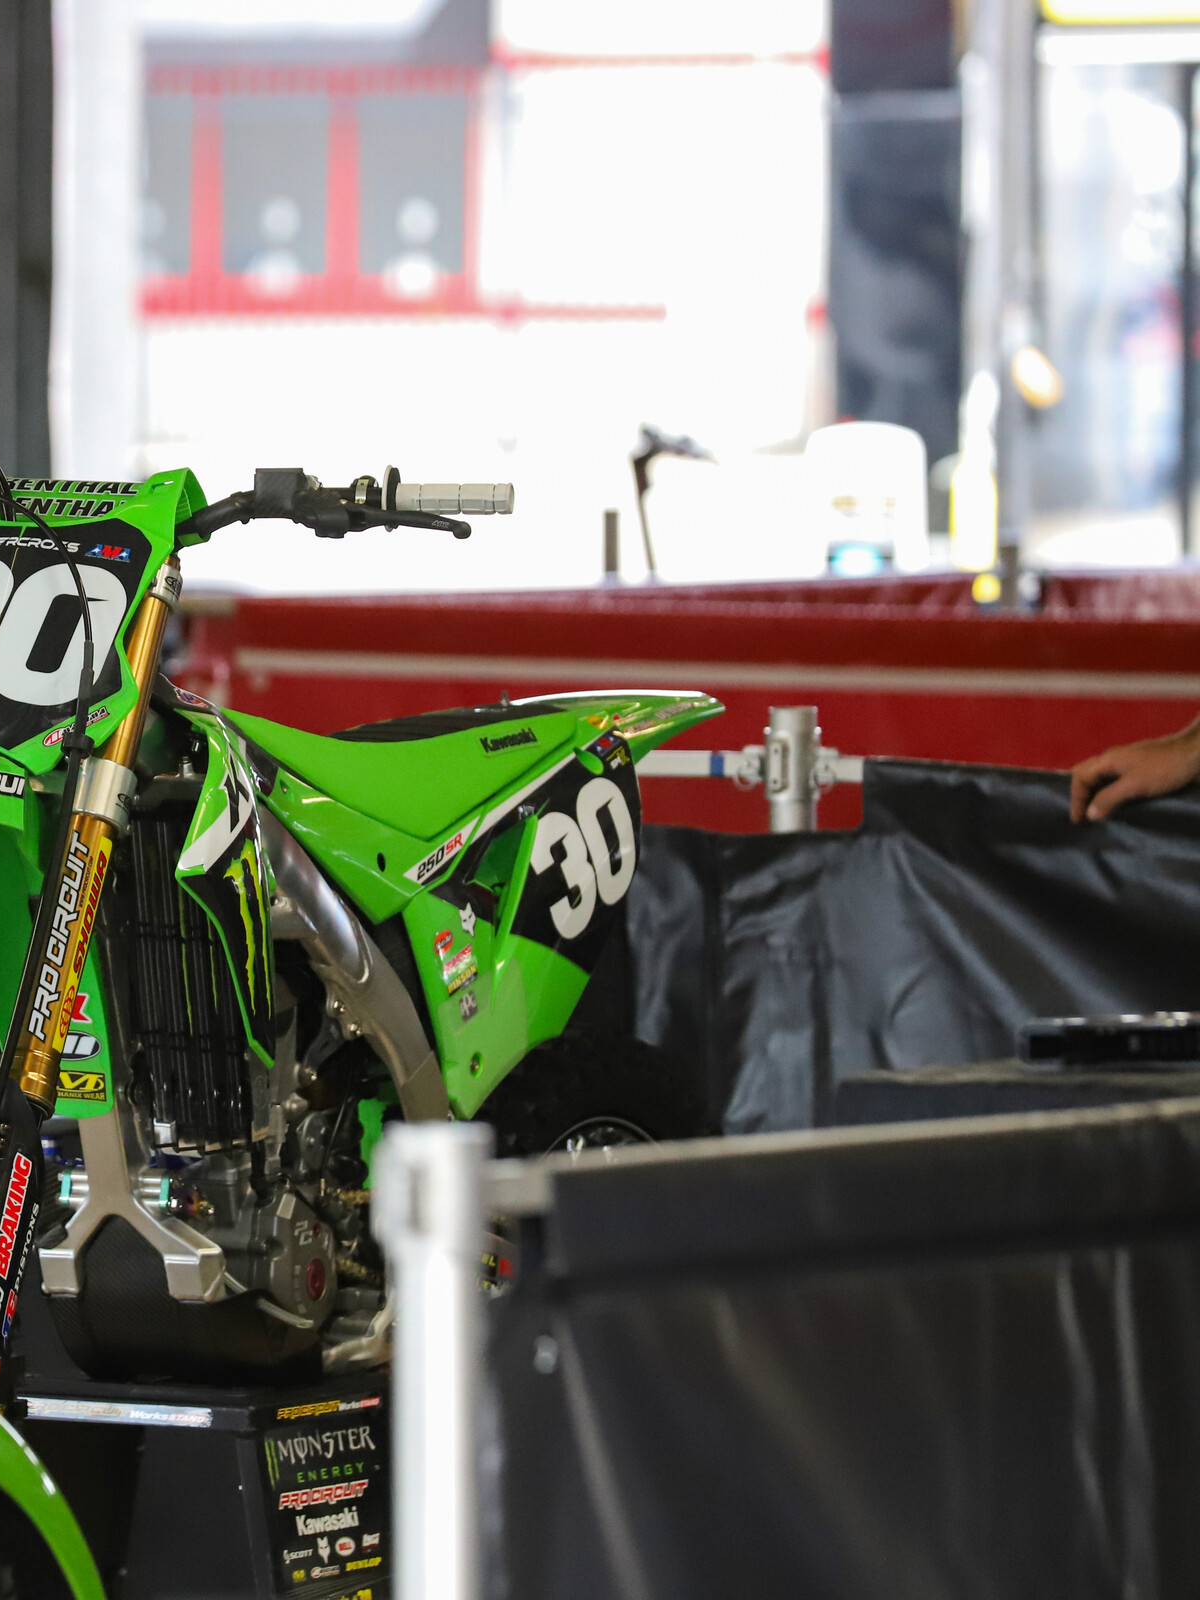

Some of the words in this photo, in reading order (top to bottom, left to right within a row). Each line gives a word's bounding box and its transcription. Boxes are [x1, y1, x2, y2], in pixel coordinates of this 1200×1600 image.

[480, 727, 537, 753] Kawasaki
[531, 776, 637, 940] 30
[73, 850, 108, 980] SHOWA
[28, 963, 61, 1042] PRO
[45, 830, 91, 967] CIRCUIT
[83, 1092, 106, 1101] WEAR
[14, 1202, 40, 1293] PISTONS
[129, 1409, 168, 1421] Works
[277, 1425, 376, 1464] MONSTER
[297, 1462, 364, 1483] ENERGY
[295, 1506, 360, 1537] Kawasaki
